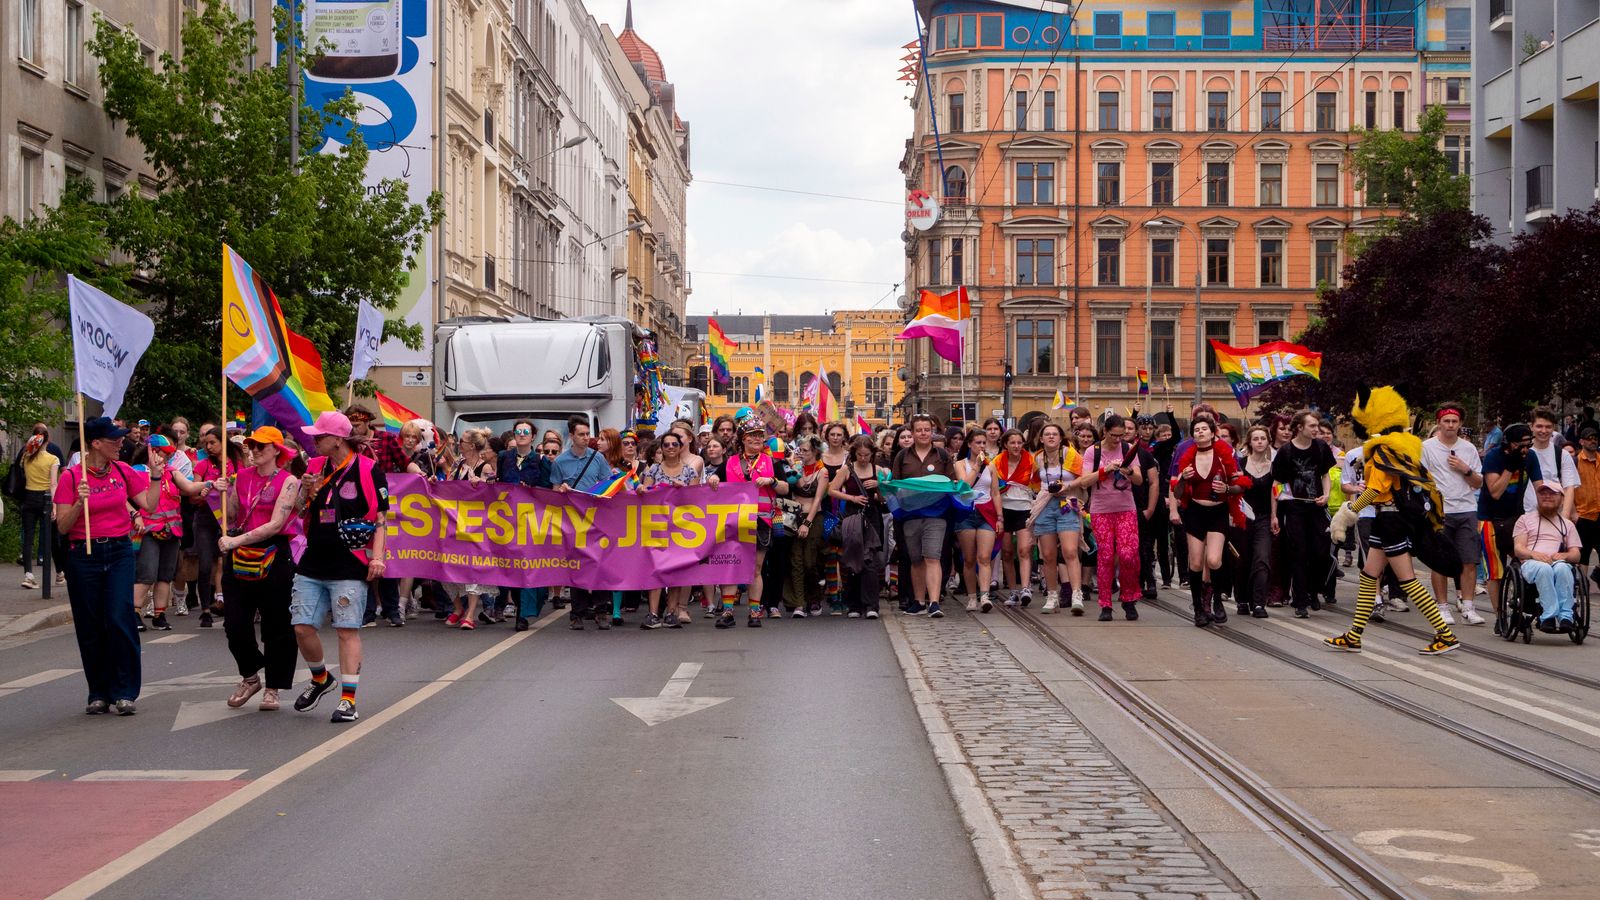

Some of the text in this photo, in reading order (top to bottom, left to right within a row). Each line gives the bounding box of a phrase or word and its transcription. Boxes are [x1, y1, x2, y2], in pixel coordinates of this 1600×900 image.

[906, 210, 930, 218] ORLEN
[386, 491, 610, 549] ESTEŚMY.
[472, 555, 511, 568] MARSZ
[513, 555, 581, 570] RÓWNOŚCI
